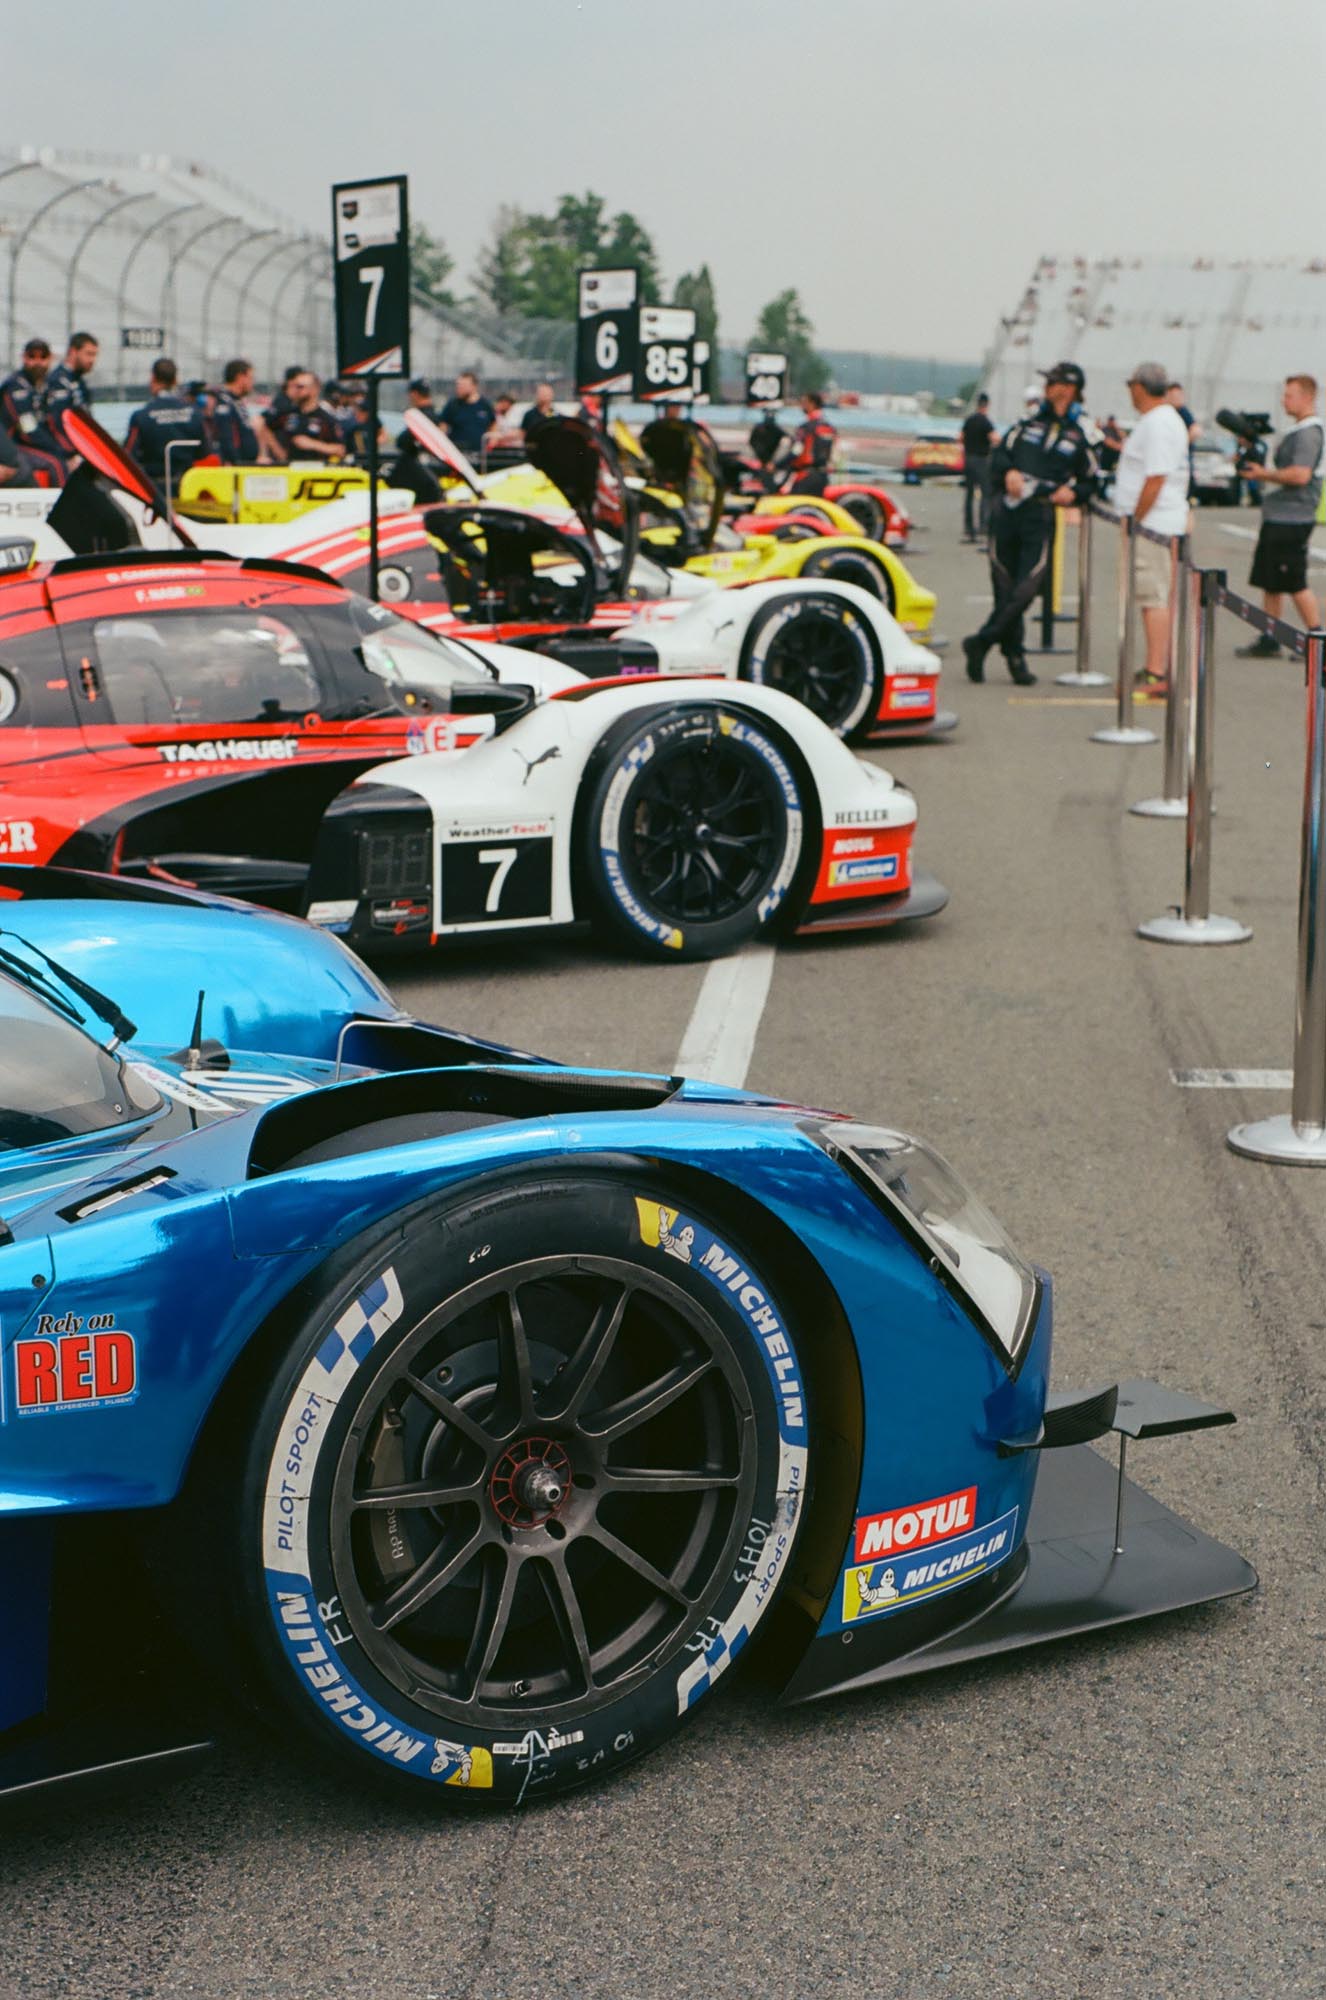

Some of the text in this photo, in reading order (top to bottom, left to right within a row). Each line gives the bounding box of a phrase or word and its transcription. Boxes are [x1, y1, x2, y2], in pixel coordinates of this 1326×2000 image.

[359, 266, 384, 337] 7
[595, 321, 619, 370] 6
[645, 345, 688, 385] 85
[835, 809, 889, 824] HELLER
[478, 848, 517, 912] 7
[35, 1312, 115, 1336] Rely on
[700, 1242, 804, 1428] MICHELIN
[15, 1331, 136, 1408] RED
[18, 1406, 50, 1416] RELIABLE
[278, 1392, 321, 1551] PILOT SPORT
[860, 1495, 970, 1555] MOTUL
[754, 1534, 787, 1607] SPORT
[902, 1530, 1008, 1590] MICHELIN
[318, 1594, 354, 1647] FR
[277, 1592, 427, 1764] MICHELIN
